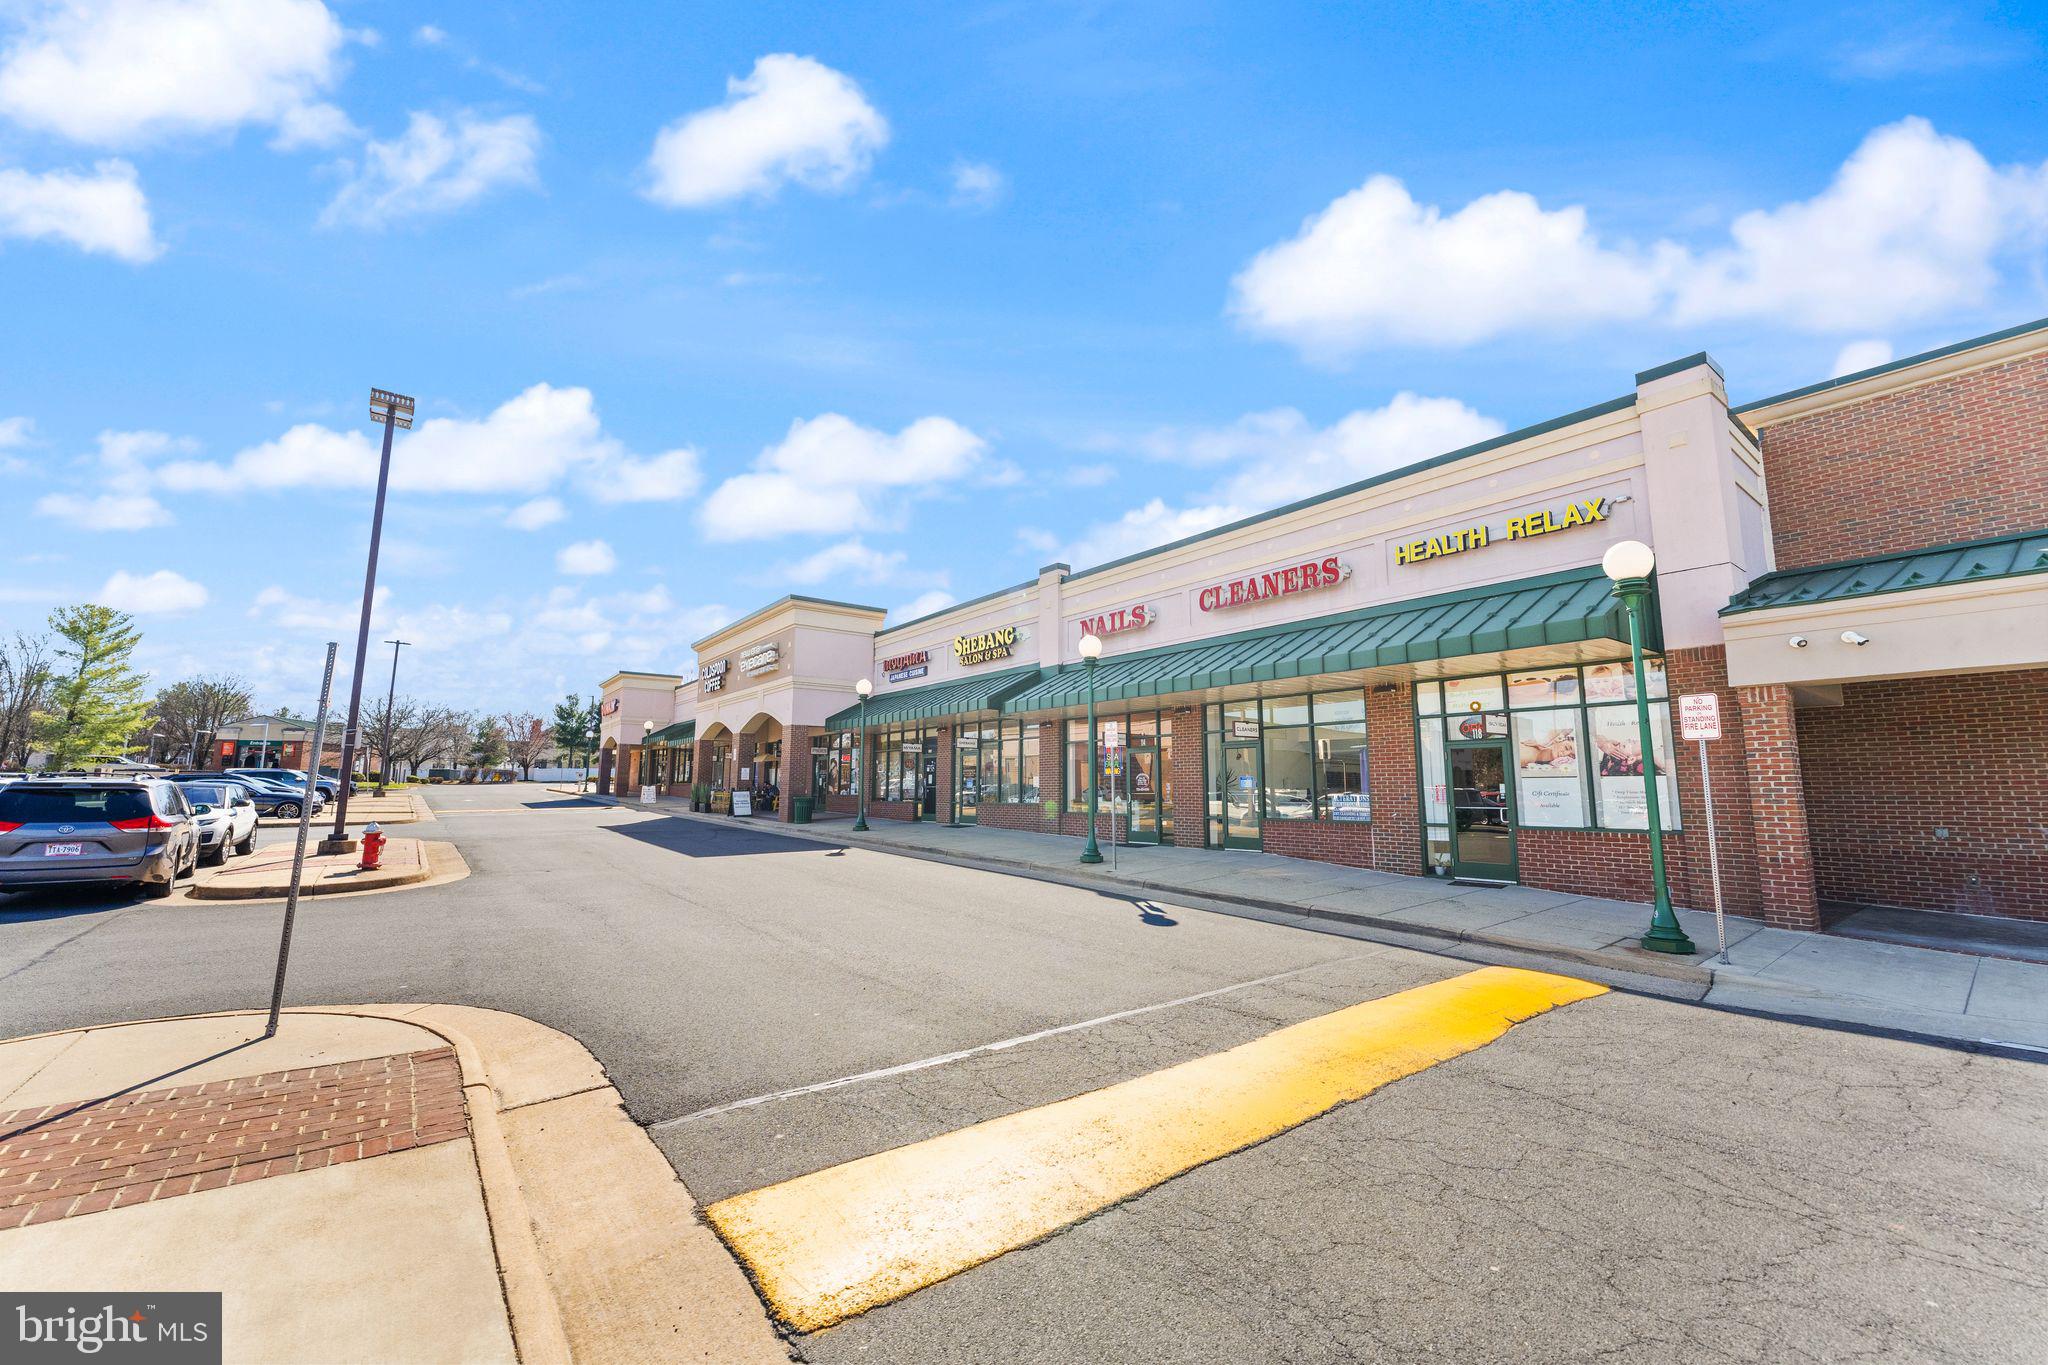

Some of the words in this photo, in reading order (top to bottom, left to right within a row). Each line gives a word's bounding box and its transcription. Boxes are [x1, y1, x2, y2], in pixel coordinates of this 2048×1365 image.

[1395, 525, 1488, 565] HEALTH
[1506, 497, 1606, 541] RELAX
[1199, 556, 1341, 613] CLEANERS
[1079, 605, 1146, 639] NAILS
[953, 626, 1016, 657] SHEBANG
[959, 653, 983, 666] SALON
[985, 651, 991, 661] &
[992, 647, 1008, 659] SPA
[890, 671, 908, 681] JAPANESE
[908, 667, 924, 677] CUISINE
[704, 675, 721, 694] COFFEE
[1684, 704, 1713, 712] PARKING
[1684, 715, 1716, 723] STANDING
[1684, 722, 1699, 731] FIRE
[1699, 721, 1717, 730] LANE
[1472, 728, 1483, 740] 118
